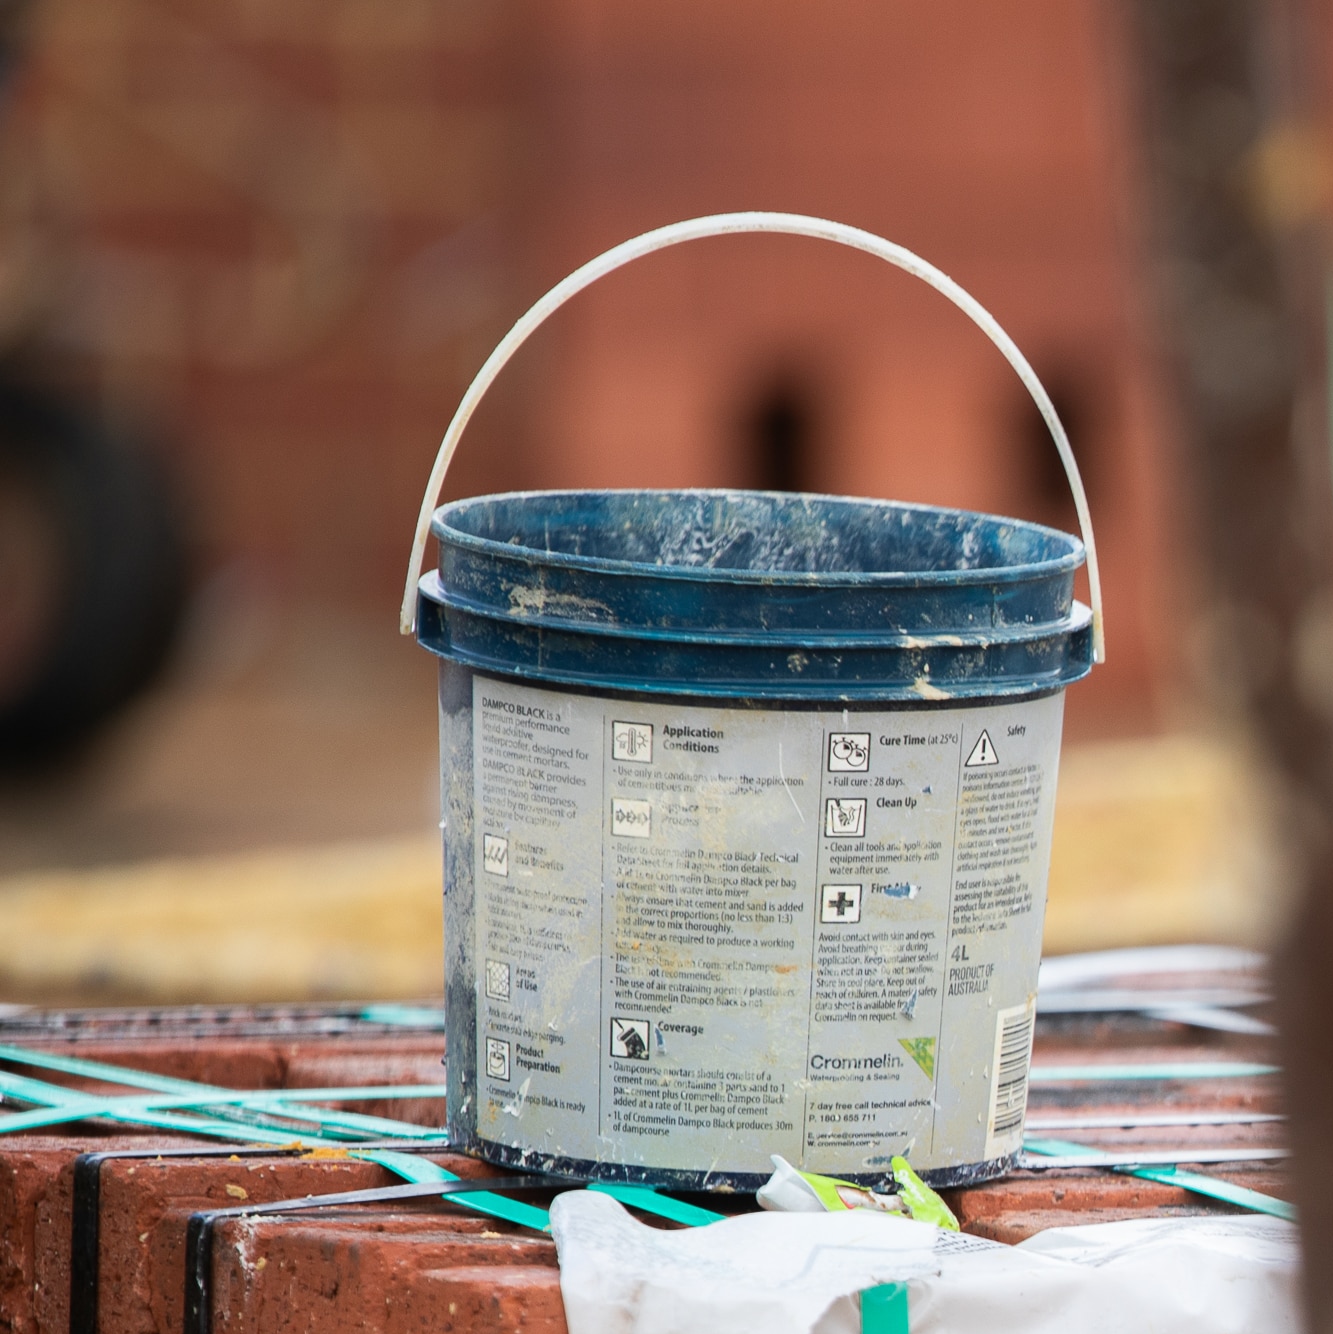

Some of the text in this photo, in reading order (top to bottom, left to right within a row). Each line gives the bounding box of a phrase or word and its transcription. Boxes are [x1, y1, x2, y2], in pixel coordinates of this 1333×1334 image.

[482, 698, 515, 712] DAMPCO
[517, 705, 545, 718] BLACK
[515, 718, 570, 734] performance
[663, 725, 724, 739] Application
[1007, 723, 1026, 736] Safety
[663, 739, 719, 753] Conditions
[879, 736, 901, 745] Cure
[903, 736, 925, 744] Time
[928, 735, 938, 746] (at
[532, 742, 588, 759] designed for
[546, 773, 586, 785] provides
[833, 778, 849, 786] Full
[874, 777, 884, 785] 28
[886, 777, 905, 788] days.
[876, 798, 917, 809] Clean Up
[830, 841, 885, 851] Clean all tools
[830, 853, 873, 865] equipment
[741, 863, 772, 873] details.
[829, 866, 852, 874] water
[741, 876, 796, 890] Black per bag
[955, 880, 967, 890] End
[705, 886, 723, 895] into
[695, 900, 727, 909] cement
[729, 901, 744, 910] and
[746, 901, 767, 910] sand
[777, 902, 804, 911] added
[641, 908, 668, 916] correct
[670, 910, 719, 920] proportions
[721, 912, 735, 923] (no
[755, 913, 774, 922] than
[777, 914, 793, 925] 1:3)
[667, 919, 683, 929] mix
[685, 920, 734, 934] thoroughly.
[669, 934, 704, 945] required
[706, 935, 715, 944] to
[717, 936, 751, 947] produce
[760, 938, 795, 950] working
[819, 931, 918, 941] Avoid contact with and
[906, 942, 928, 953] during
[951, 945, 969, 961] 4L
[864, 955, 882, 966] Keep
[950, 966, 984, 980] PRODUCT
[524, 981, 537, 991] Use
[615, 977, 629, 987] The
[656, 980, 666, 990] air
[887, 977, 904, 988] Keep
[906, 976, 916, 985] out
[948, 979, 988, 995] AUSTRALIA
[615, 990, 633, 999] with
[816, 990, 836, 998] reach
[918, 987, 937, 998] safety
[864, 1000, 896, 1008] available
[869, 1011, 897, 1023] request.
[657, 1021, 704, 1035] Coverage
[516, 1044, 543, 1057] Product
[516, 1057, 561, 1073] Preparation
[613, 1062, 661, 1075] Dampcourse
[613, 1076, 642, 1084] cement
[874, 1073, 900, 1081] Sealing
[662, 1089, 679, 1100] plus
[566, 1101, 585, 1113] ready
[613, 1097, 637, 1107] added
[655, 1101, 671, 1110] rate
[695, 1104, 708, 1114] per
[710, 1103, 725, 1115] bag
[737, 1106, 768, 1115] cement
[817, 1102, 833, 1111] day
[871, 1099, 906, 1108] technical
[908, 1098, 930, 1106] advice
[623, 1112, 632, 1121] of
[633, 1113, 676, 1124] Crommelin
[678, 1116, 711, 1128] Dampco
[713, 1119, 734, 1128] Black
[736, 1120, 773, 1131] produces
[775, 1121, 793, 1130] 30m
[843, 1113, 859, 1121] 655
[623, 1123, 669, 1136] dampcourse
